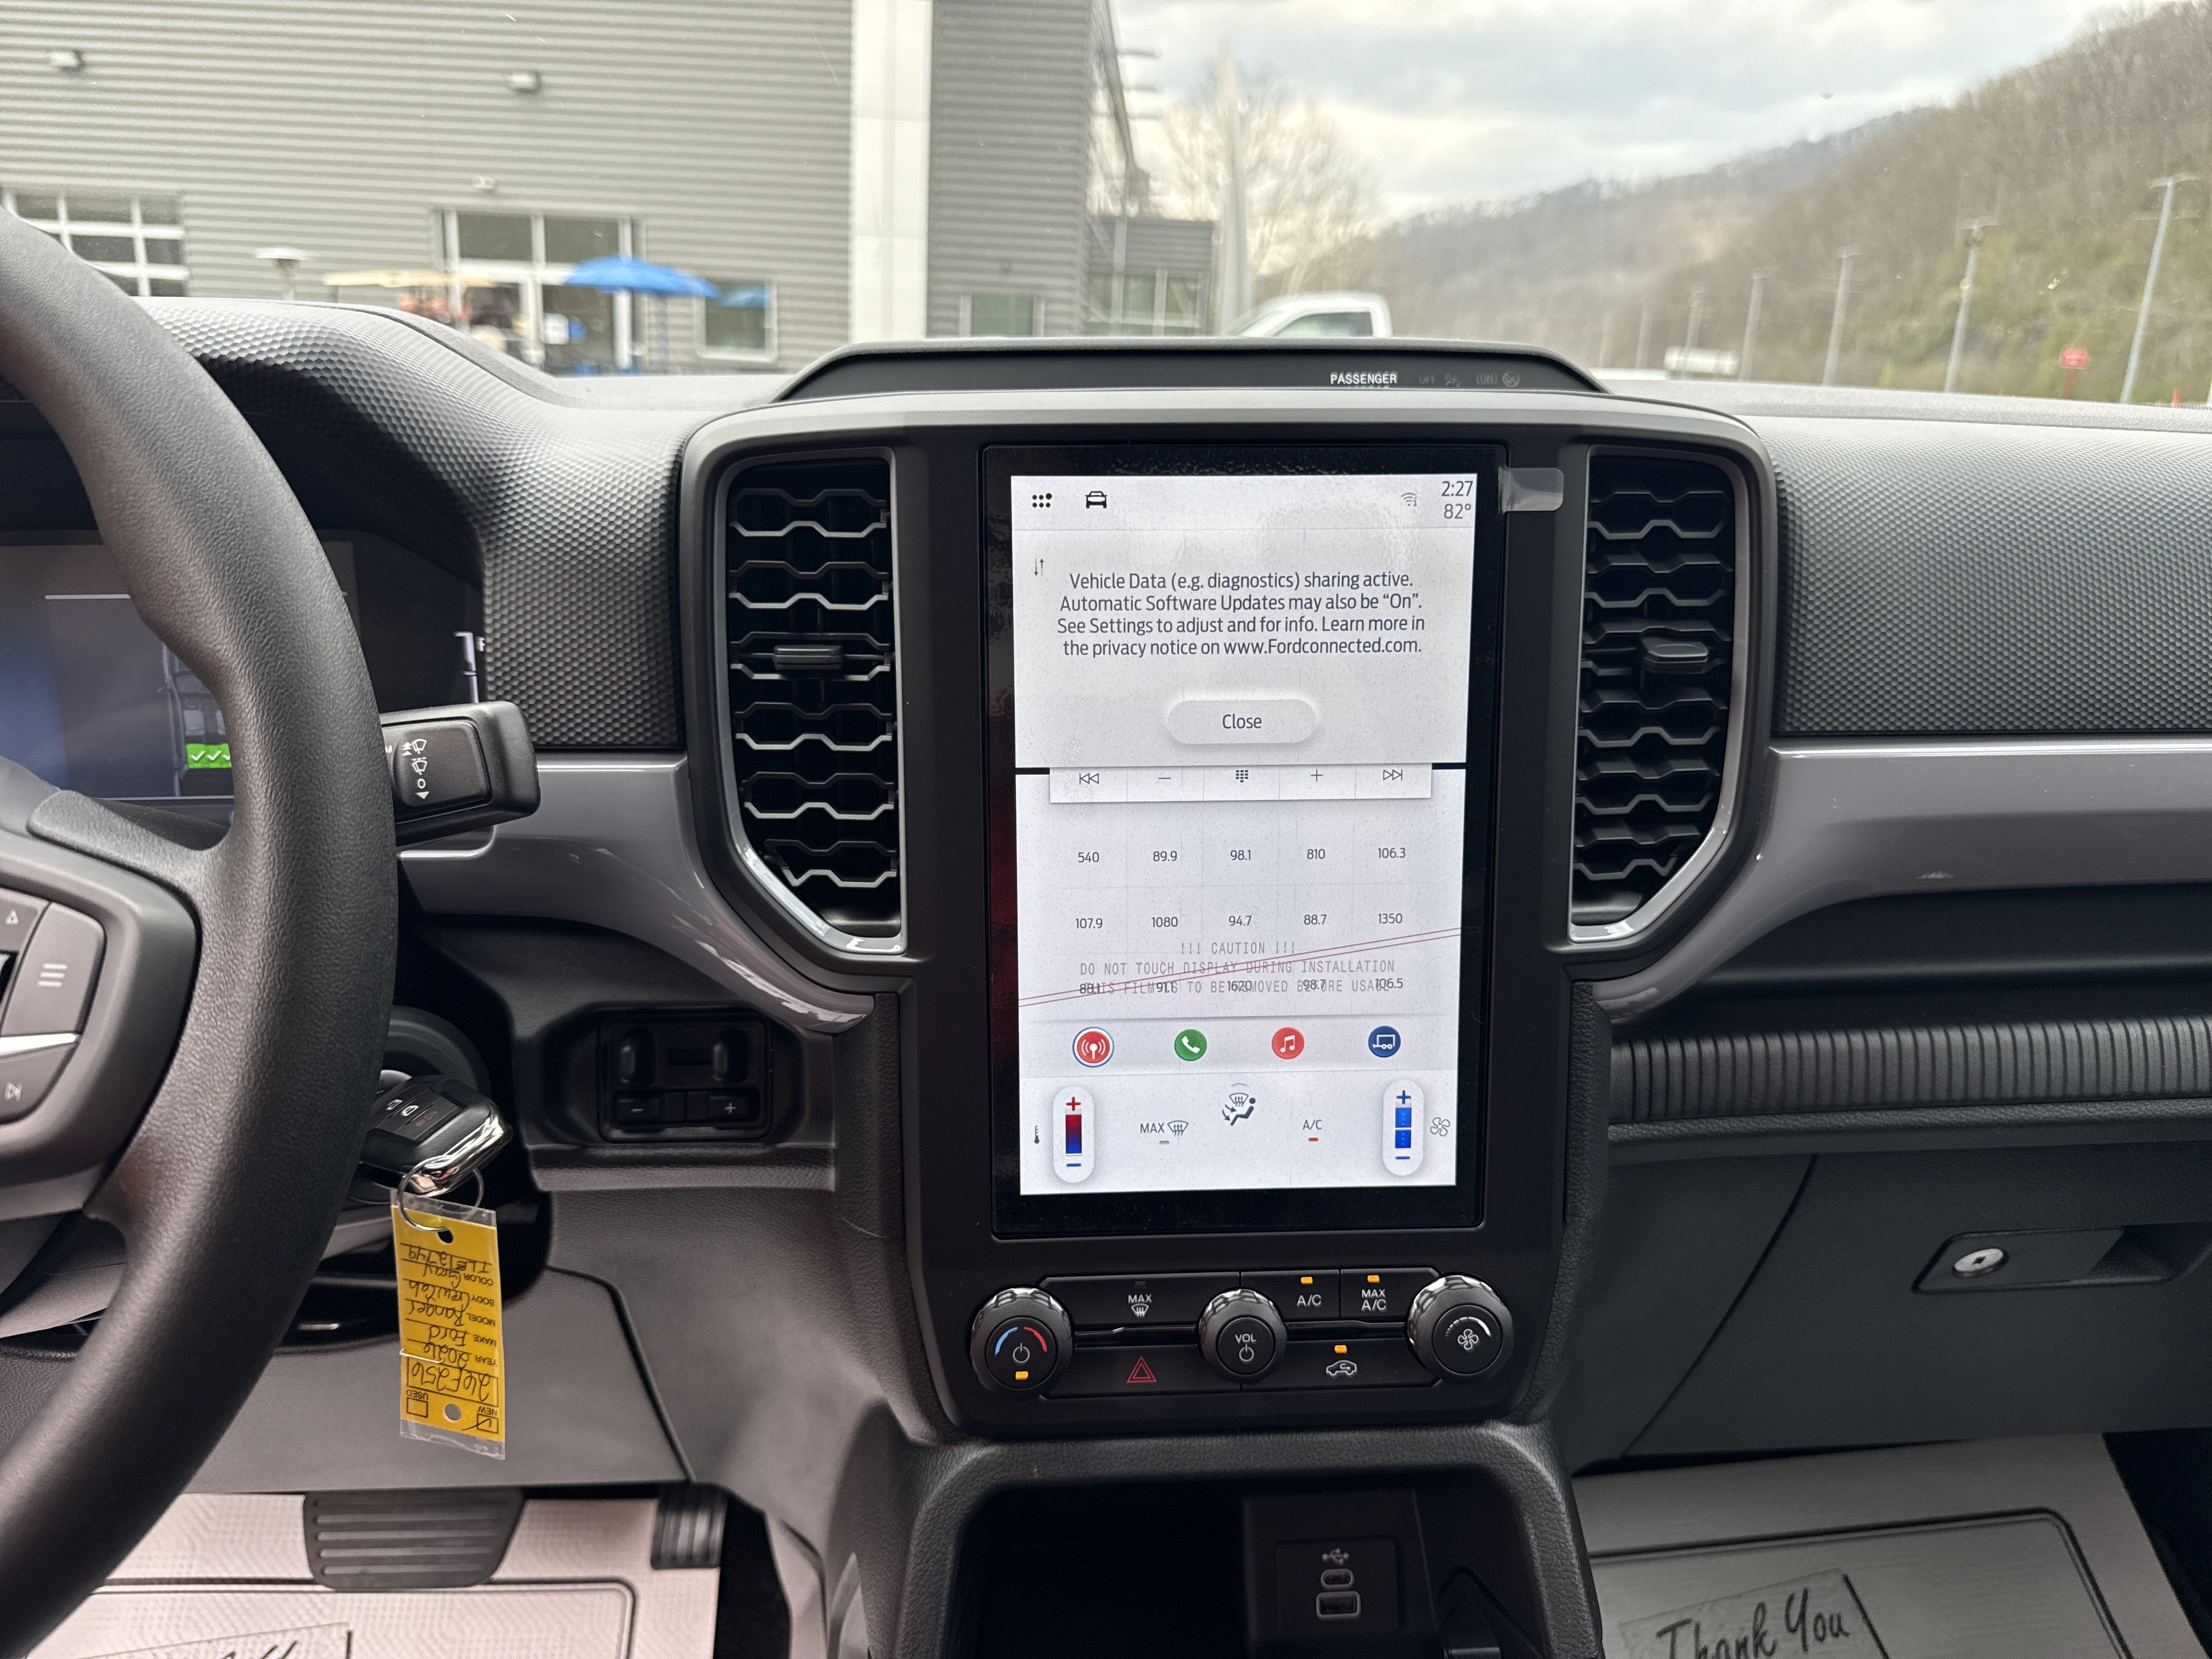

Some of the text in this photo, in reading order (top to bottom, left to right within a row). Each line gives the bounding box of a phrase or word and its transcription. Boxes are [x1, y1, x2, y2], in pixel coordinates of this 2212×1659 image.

[1330, 372, 1397, 385] PASSENGER
[1441, 480, 1474, 497] 2:27
[1443, 503, 1472, 520] 82°
[1069, 571, 1413, 592] Vehicle Data (e.g. diagnostics) sharing active.
[1060, 592, 1422, 613] Automatic Software Updates may also be “On”.
[1057, 615, 1425, 636] See Settings to adjust and for info. Learn more in
[1063, 636, 1422, 658] the privacy notice on www.Fordconnected.com.
[1222, 713, 1262, 729] Close
[1077, 851, 1100, 863] 540
[1153, 850, 1178, 862] 89.9
[1230, 849, 1251, 861] 98.1
[1306, 848, 1326, 860] 810
[1378, 847, 1406, 859] 106.3
[1075, 917, 1103, 929] 107.9
[1152, 916, 1178, 928] 1080
[1228, 915, 1252, 927] 94.7
[1304, 914, 1327, 926] 88.7
[1378, 913, 1403, 924] 1350
[1181, 941, 1295, 955] !!! CAUTION !!!
[1080, 960, 1394, 975] DO NOT TOUCH DISPLAY DURING INSTALLATION
[1124, 982, 1154, 994] FILM
[1187, 981, 1201, 993] TO
[1211, 981, 1224, 992] BE
[1227, 980, 1252, 991] 1620
[1375, 978, 1403, 989] 106.5
[1140, 1122, 1165, 1133] MAX
[1302, 1119, 1322, 1130] A/C
[462, 1273, 494, 1286] COLOR
[1128, 1294, 1152, 1304] MAX
[1361, 1289, 1386, 1298] MAX
[471, 1295, 495, 1306] BODY
[1296, 1294, 1322, 1306] A/C
[1361, 1299, 1386, 1311] A/C
[465, 1312, 496, 1327] MODEL
[428, 1325, 496, 1346] MAKE Ford
[1235, 1333, 1257, 1344] VOL
[475, 1355, 498, 1367] YEAR
[406, 1389, 428, 1401] USED
[478, 1406, 498, 1415] NEW
[1656, 1587, 1849, 1659] Thank You
